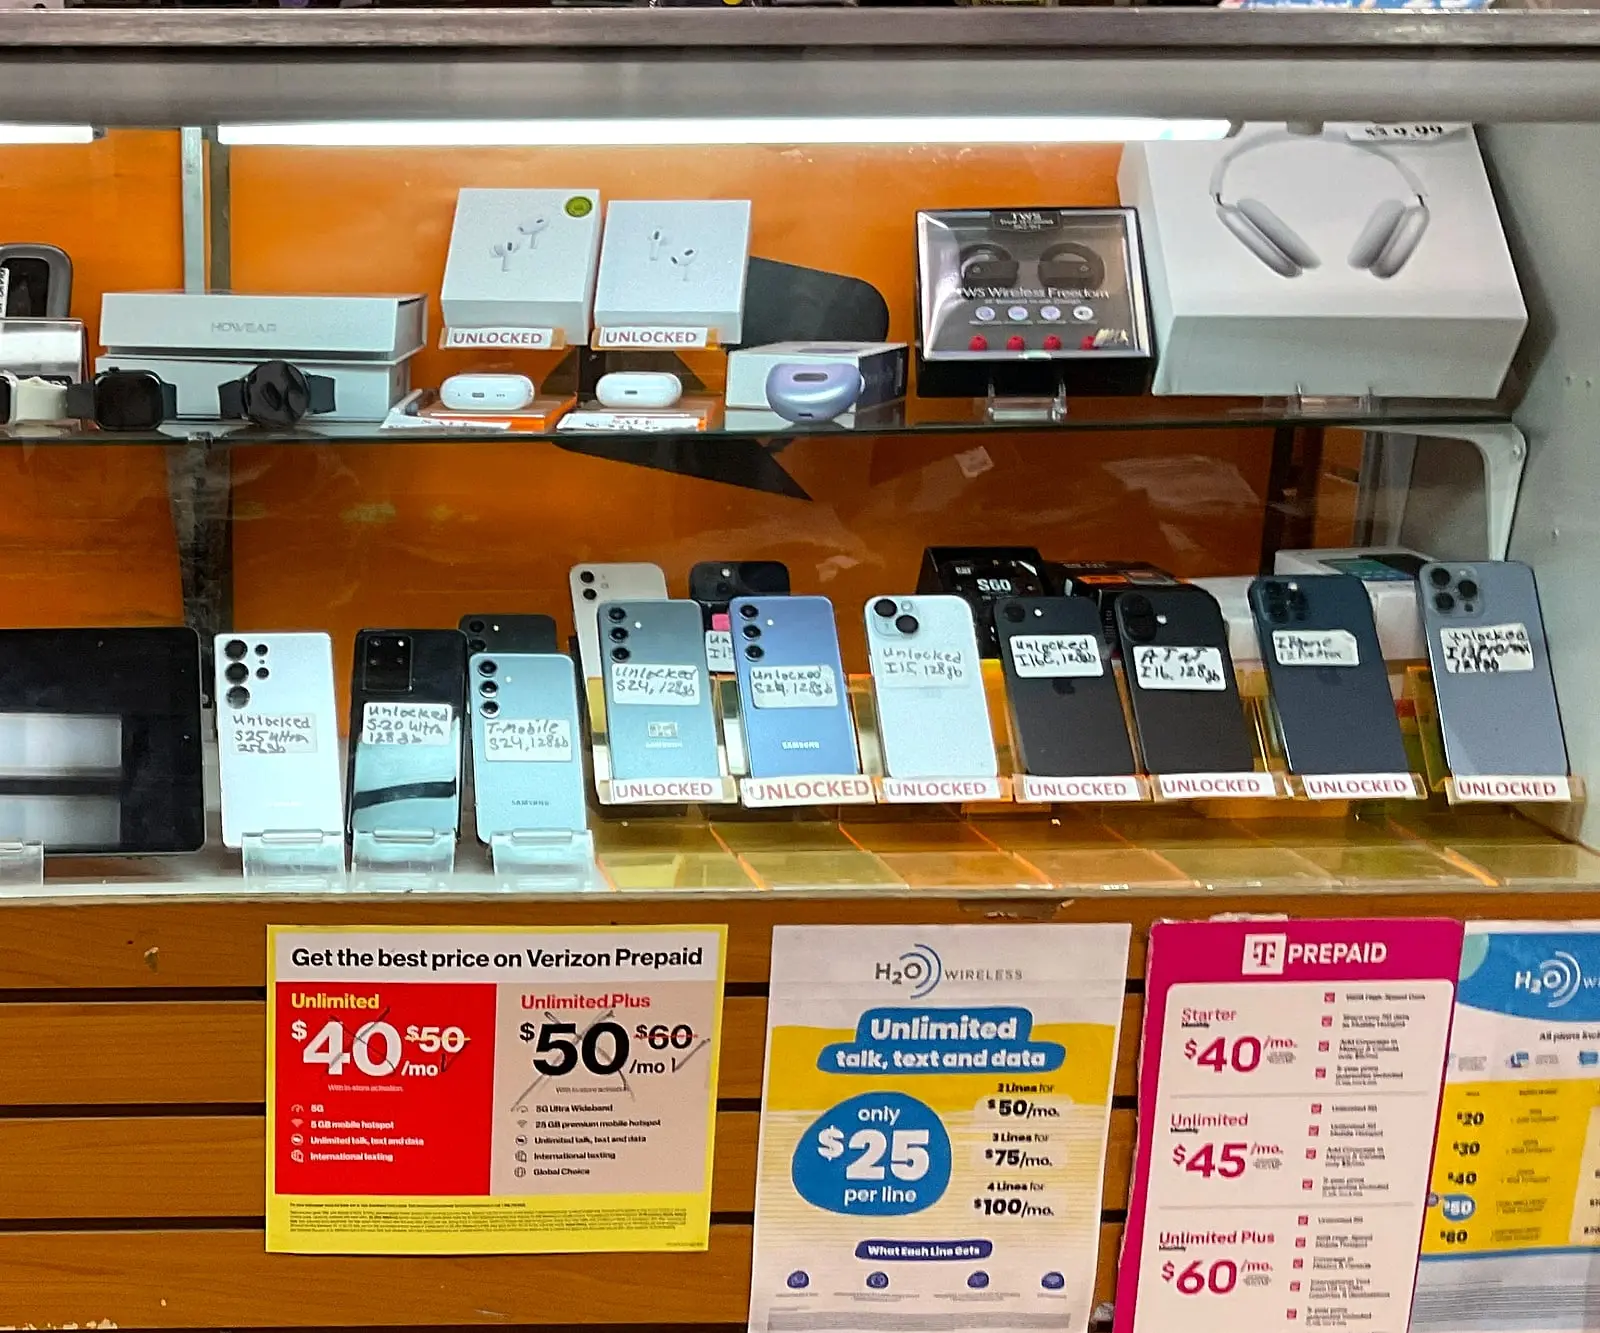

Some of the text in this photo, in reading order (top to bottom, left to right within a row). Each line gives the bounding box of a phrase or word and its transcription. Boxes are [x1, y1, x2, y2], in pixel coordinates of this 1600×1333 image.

[452, 331, 543, 345] UNLOCKED
[605, 330, 698, 344] UNLOCKED
[1015, 637, 1090, 654] Unlocked
[882, 647, 962, 664] Unlocked
[614, 667, 698, 682] Unlocked
[752, 665, 822, 681] Unlocked
[368, 705, 449, 721] Unlocked
[486, 717, 560, 735] T-Mobile
[781, 741, 821, 750] SAMSUNG
[615, 782, 714, 799] UNLOCKED
[749, 779, 871, 802] UNLOCKED
[888, 781, 988, 797] UNLOCKED
[1028, 782, 1127, 797] UNLOCKED
[1163, 778, 1261, 794] UNLOCKED
[1308, 778, 1408, 796] UNLOCKED
[1458, 781, 1557, 797] UNLOCKED
[291, 947, 703, 971] Get the best price on Verizon Prepaid
[1287, 942, 1388, 965] PREPAID
[944, 968, 1024, 982] WIRELESS
[291, 992, 380, 1009] Unlimited
[520, 992, 651, 1010] Unlimited Plus
[1180, 1007, 1238, 1022] Starter
[870, 1014, 1018, 1042] Unlimited
[290, 1018, 466, 1077] $40 $50
[519, 1021, 693, 1077] $50 $60
[835, 1049, 1046, 1071] talk, text and data
[1005, 1082, 1038, 1093] Lines
[1039, 1082, 1055, 1093] for
[549, 1104, 570, 1113] Ultra
[571, 1103, 614, 1113] Wideband
[857, 1105, 901, 1127] only
[332, 1120, 361, 1129] mobile
[361, 1121, 394, 1130] hotspot
[561, 1120, 599, 1130] premium
[599, 1119, 629, 1128] mobile
[629, 1118, 661, 1128] hotspot
[1170, 1112, 1249, 1128] Unlimited
[310, 1136, 351, 1145] Unlimited
[371, 1137, 388, 1146] text
[388, 1137, 405, 1146] and
[404, 1137, 425, 1146] data
[534, 1136, 575, 1145] Unlimited
[594, 1136, 611, 1144] text
[611, 1135, 627, 1143] and
[627, 1135, 647, 1143] data
[1000, 1131, 1032, 1143] Lines
[1034, 1132, 1049, 1143] for
[310, 1152, 394, 1163] International texting
[533, 1152, 617, 1161] International texting
[816, 1125, 930, 1182] $25
[533, 1167, 591, 1176] Global Choice
[986, 1181, 1045, 1192] 4 Lines for
[843, 1185, 917, 1207] per line
[1158, 1229, 1276, 1246] Unlimited Plus
[867, 1245, 981, 1257] What Each Line Gets
